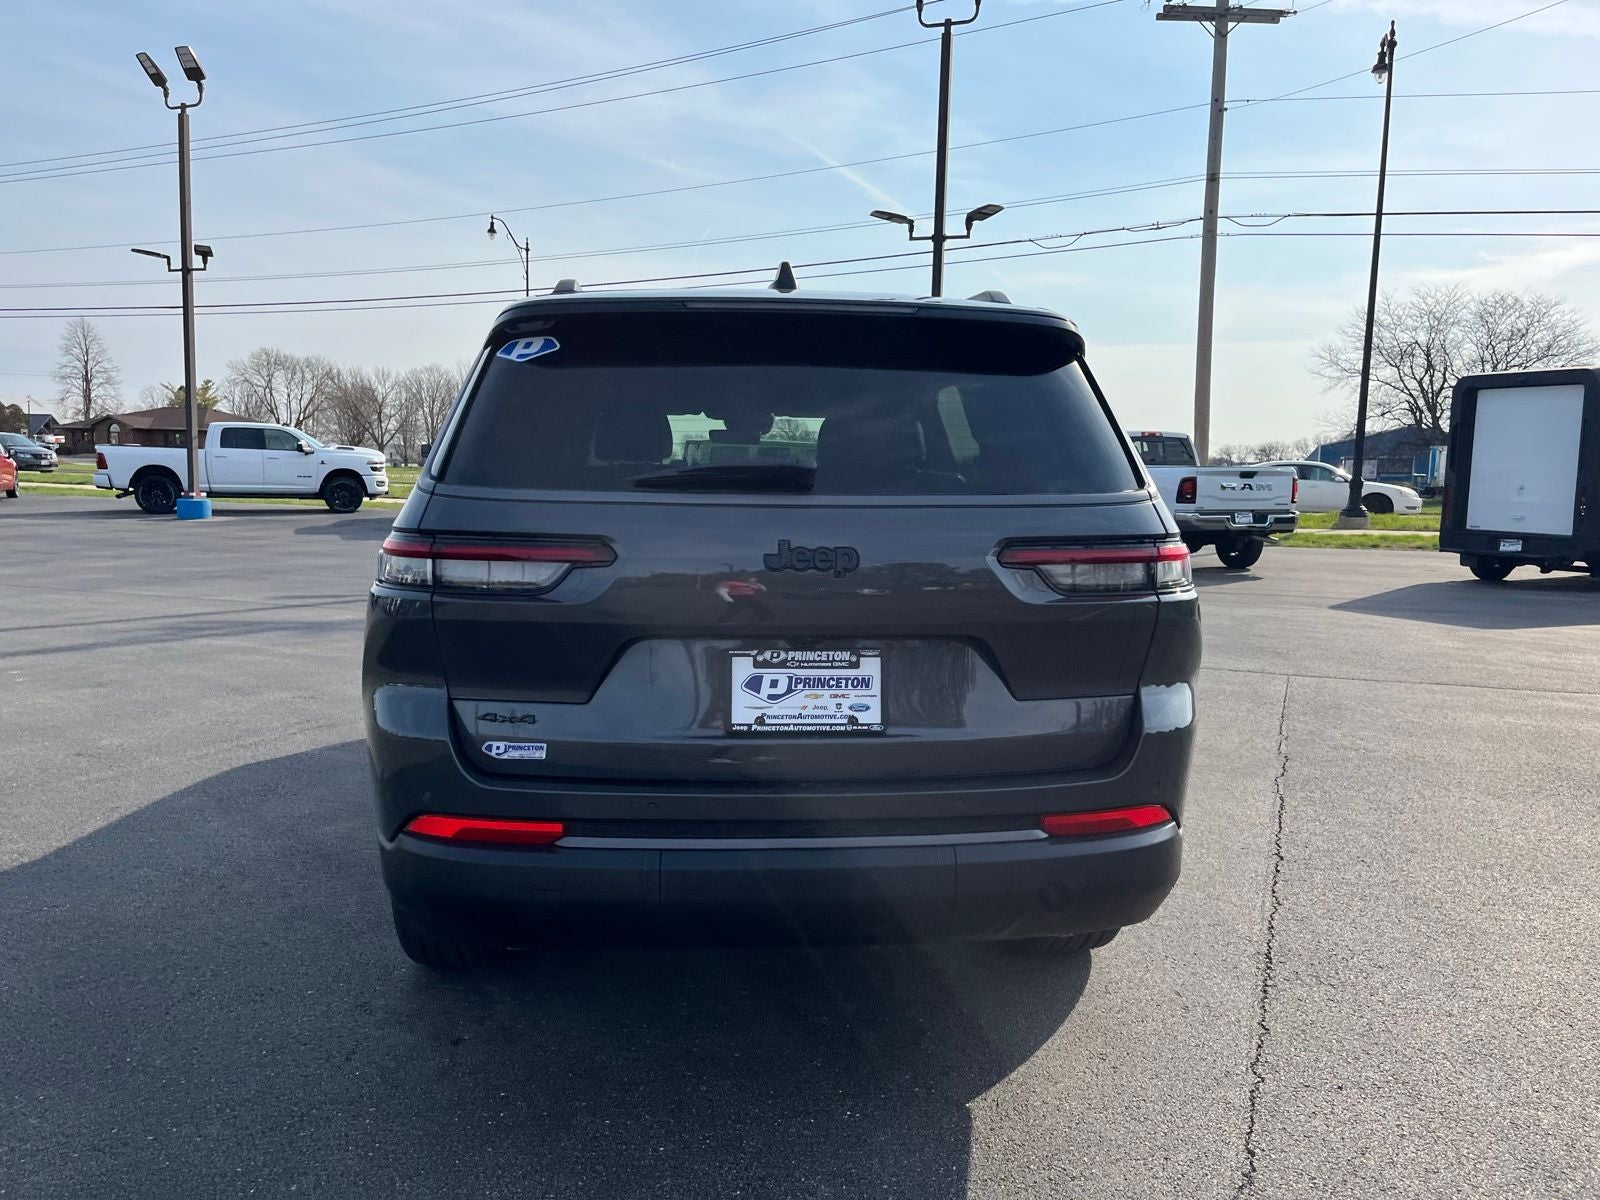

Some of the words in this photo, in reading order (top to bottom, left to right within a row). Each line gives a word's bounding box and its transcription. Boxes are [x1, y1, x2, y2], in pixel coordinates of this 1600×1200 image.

[1221, 482, 1273, 491] RAM
[763, 539, 860, 579] Jeep
[788, 651, 851, 661] PRINCETON
[793, 677, 871, 689] PRINCETON
